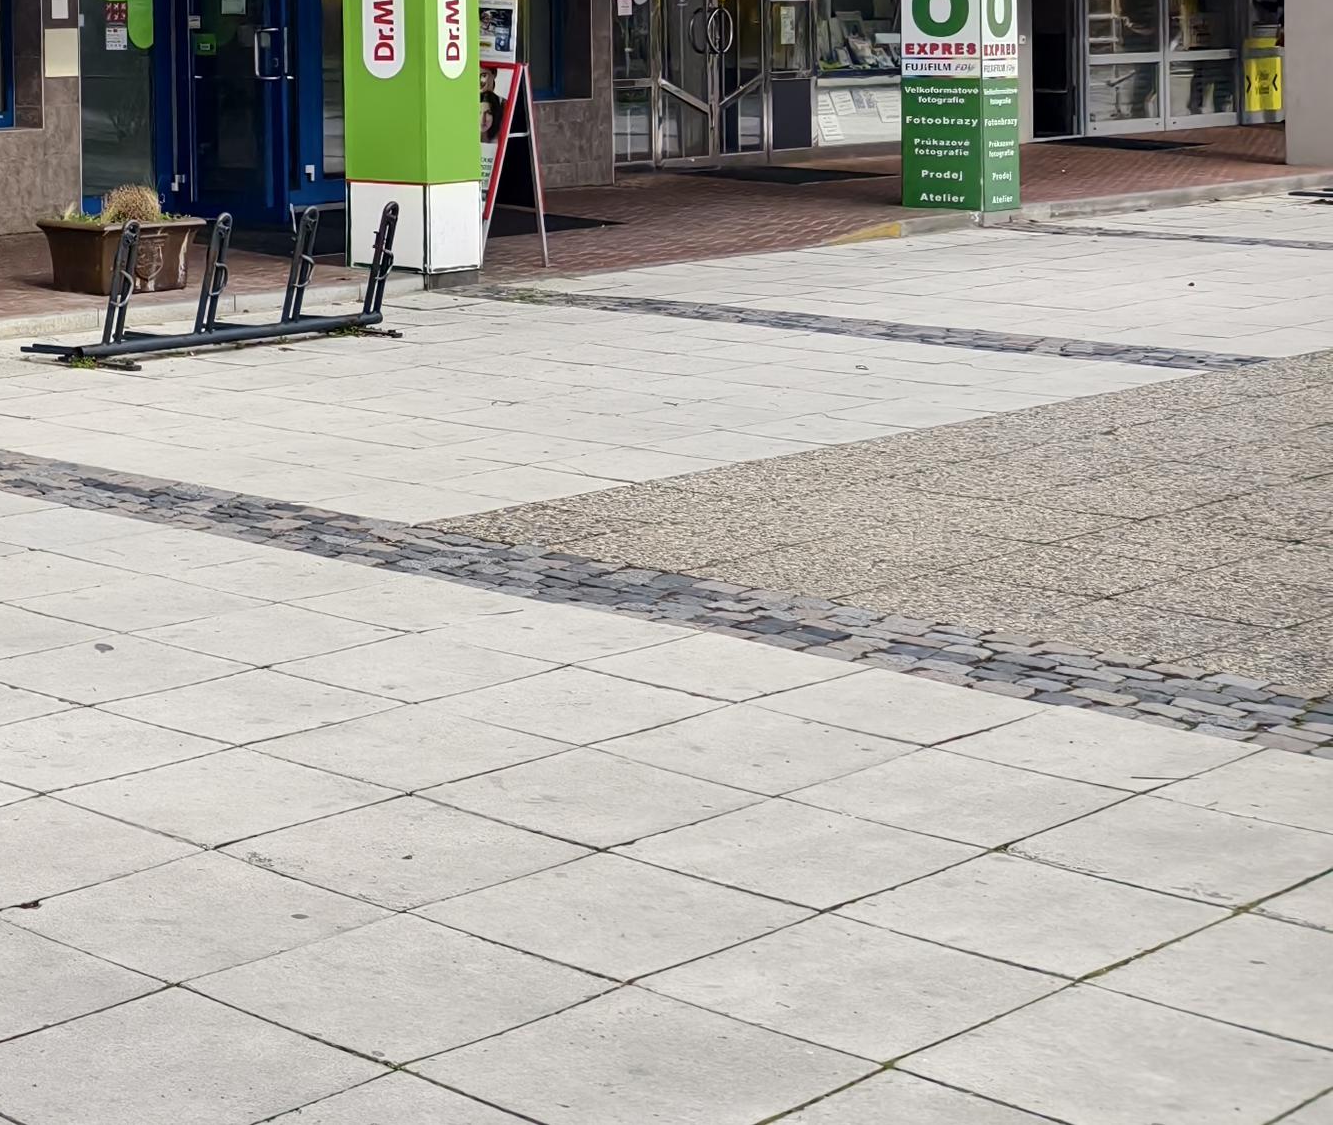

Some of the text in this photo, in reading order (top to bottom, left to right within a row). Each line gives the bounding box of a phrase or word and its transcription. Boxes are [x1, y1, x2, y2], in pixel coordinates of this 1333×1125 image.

[905, 43, 976, 55] EXPRES
[983, 44, 1016, 56] EXPRES
[918, 96, 965, 105] fotografie
[905, 116, 978, 127] Fotoobrazy
[914, 138, 970, 146] Průkazové
[914, 147, 970, 157] fotografie
[921, 170, 963, 181] Prodej
[920, 192, 966, 203] Atelier
